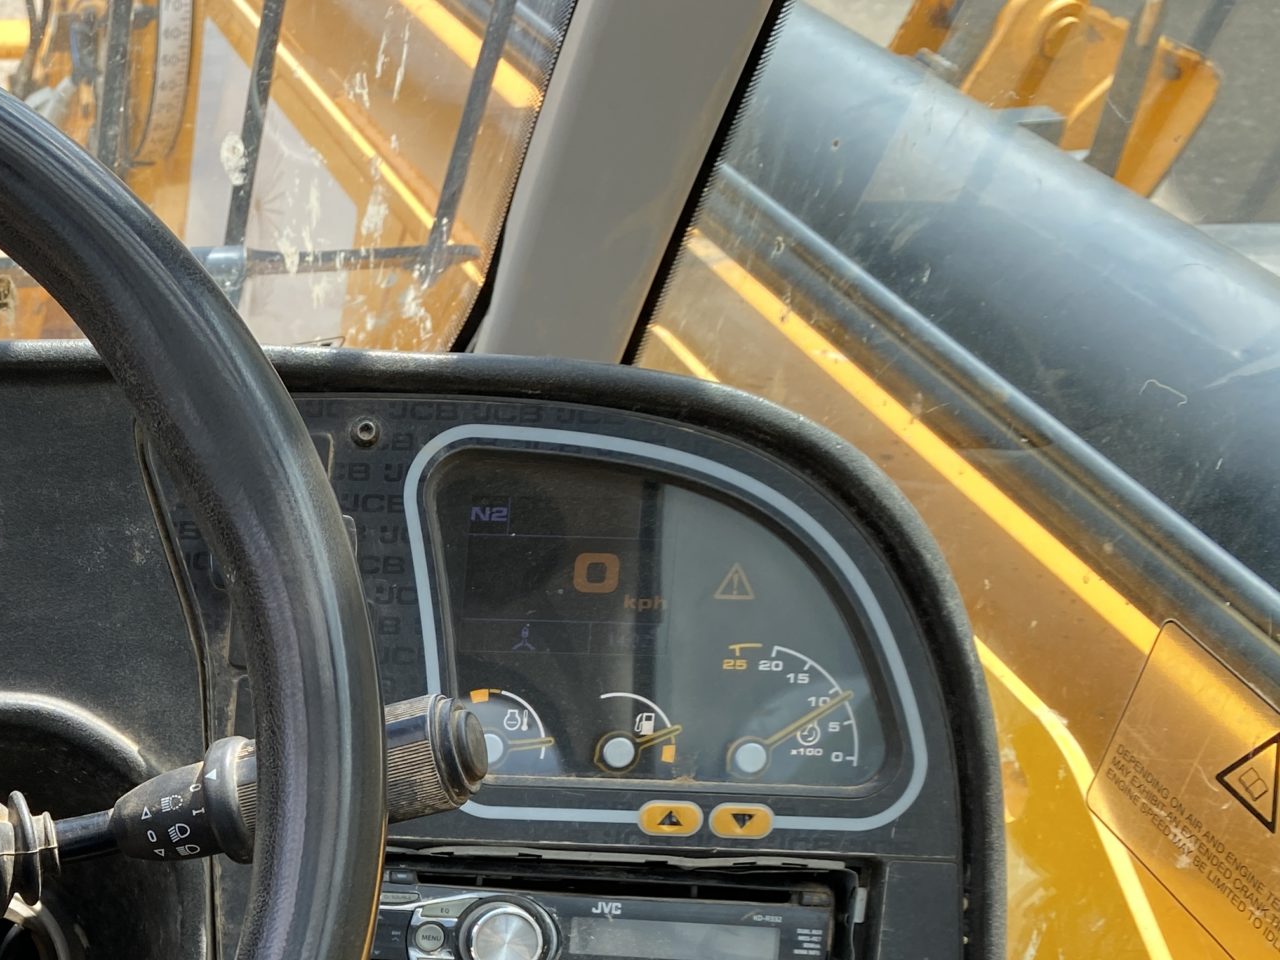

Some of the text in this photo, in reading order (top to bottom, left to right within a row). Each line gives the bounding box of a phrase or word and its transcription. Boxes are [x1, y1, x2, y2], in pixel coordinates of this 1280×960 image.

[389, 401, 458, 420] JCB
[474, 403, 543, 423] JCB
[470, 506, 508, 522] N2
[360, 555, 405, 574] CB
[376, 585, 418, 604] JC
[722, 659, 748, 670] 25
[758, 660, 784, 671] 20
[785, 673, 810, 684] 15
[807, 696, 831, 707] 10
[828, 722, 840, 732] 5
[831, 752, 843, 762] 0
[1112, 756, 1131, 777] MAY
[1130, 775, 1167, 810] EXHIBIT
[1180, 824, 1232, 880] EXTENDED
[1116, 744, 1169, 799] DEPENDING
[1170, 796, 1185, 816] ON
[1185, 813, 1203, 833] AIR
[1202, 830, 1225, 854] AND
[1225, 851, 1266, 895] ENGINE
[1106, 767, 1138, 806] ENGINE
[1140, 802, 1172, 837] SPEED
[1192, 854, 1208, 874] BE
[1207, 869, 1247, 913] LIMITED
[1247, 909, 1263, 930] TO
[1263, 926, 1280, 953] IDL
[592, 902, 622, 914] JVC
